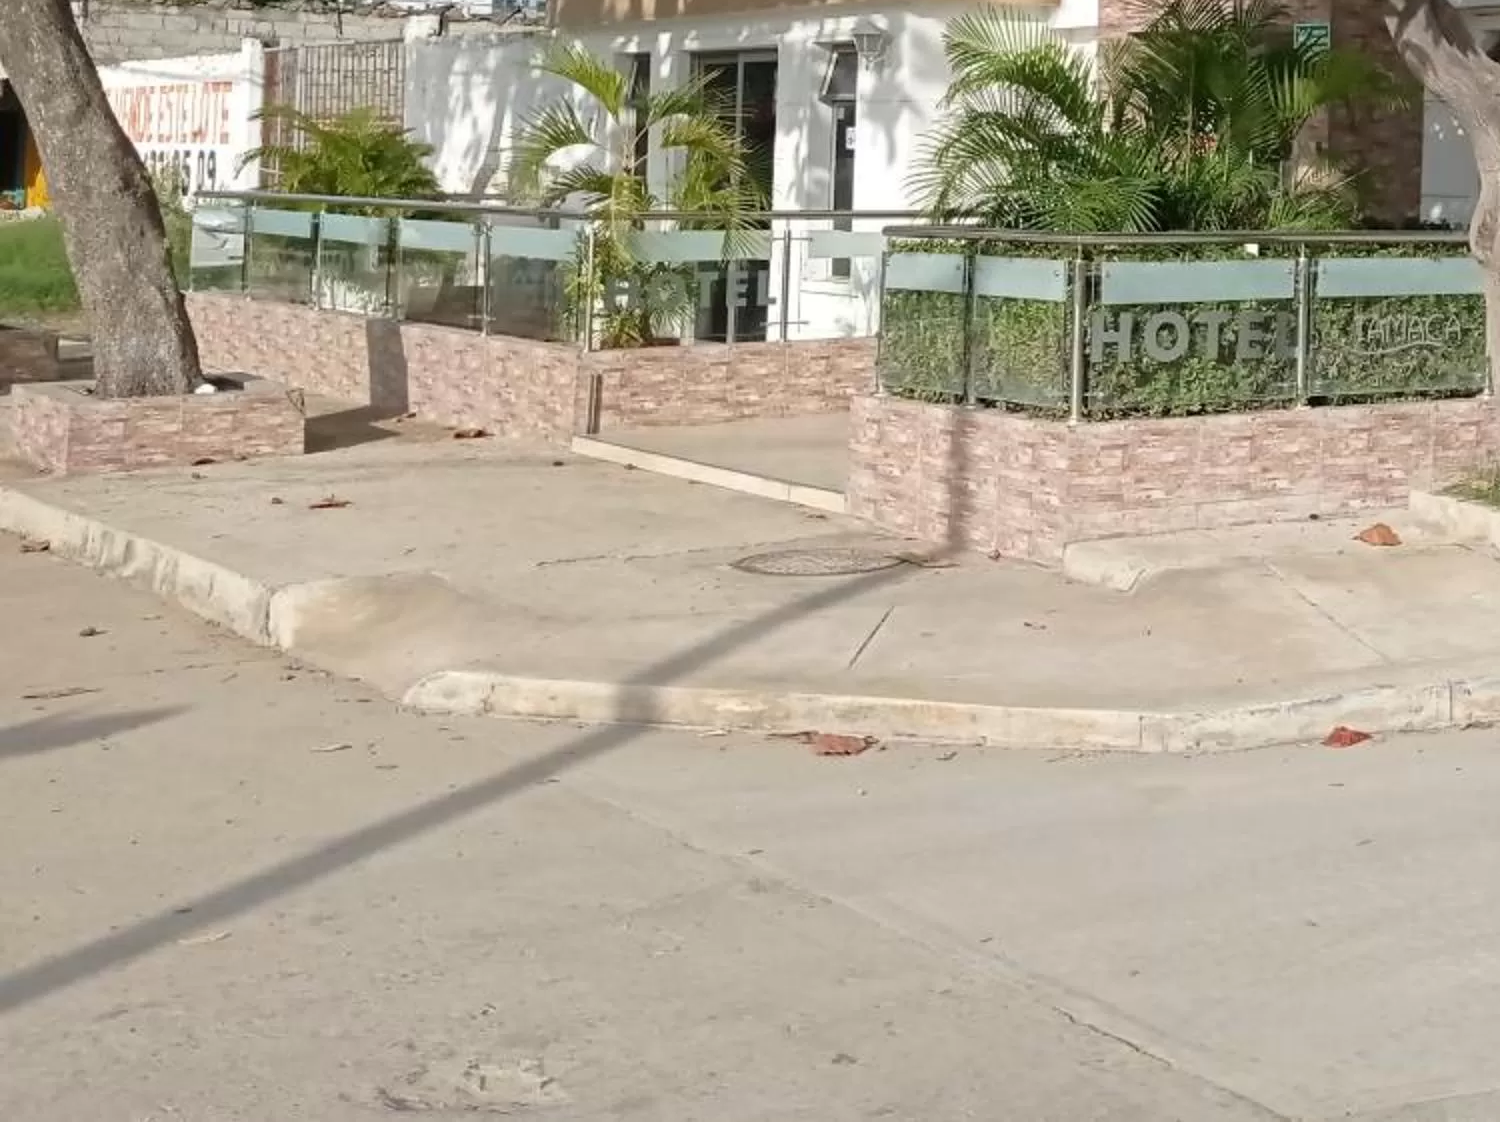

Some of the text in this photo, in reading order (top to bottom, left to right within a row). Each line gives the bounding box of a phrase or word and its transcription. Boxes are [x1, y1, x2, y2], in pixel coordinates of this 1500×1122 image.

[157, 84, 189, 144] ESTE
[191, 81, 232, 144] LOTE
[605, 270, 776, 309] HOTEL
[1091, 311, 1301, 363] HOTEL
